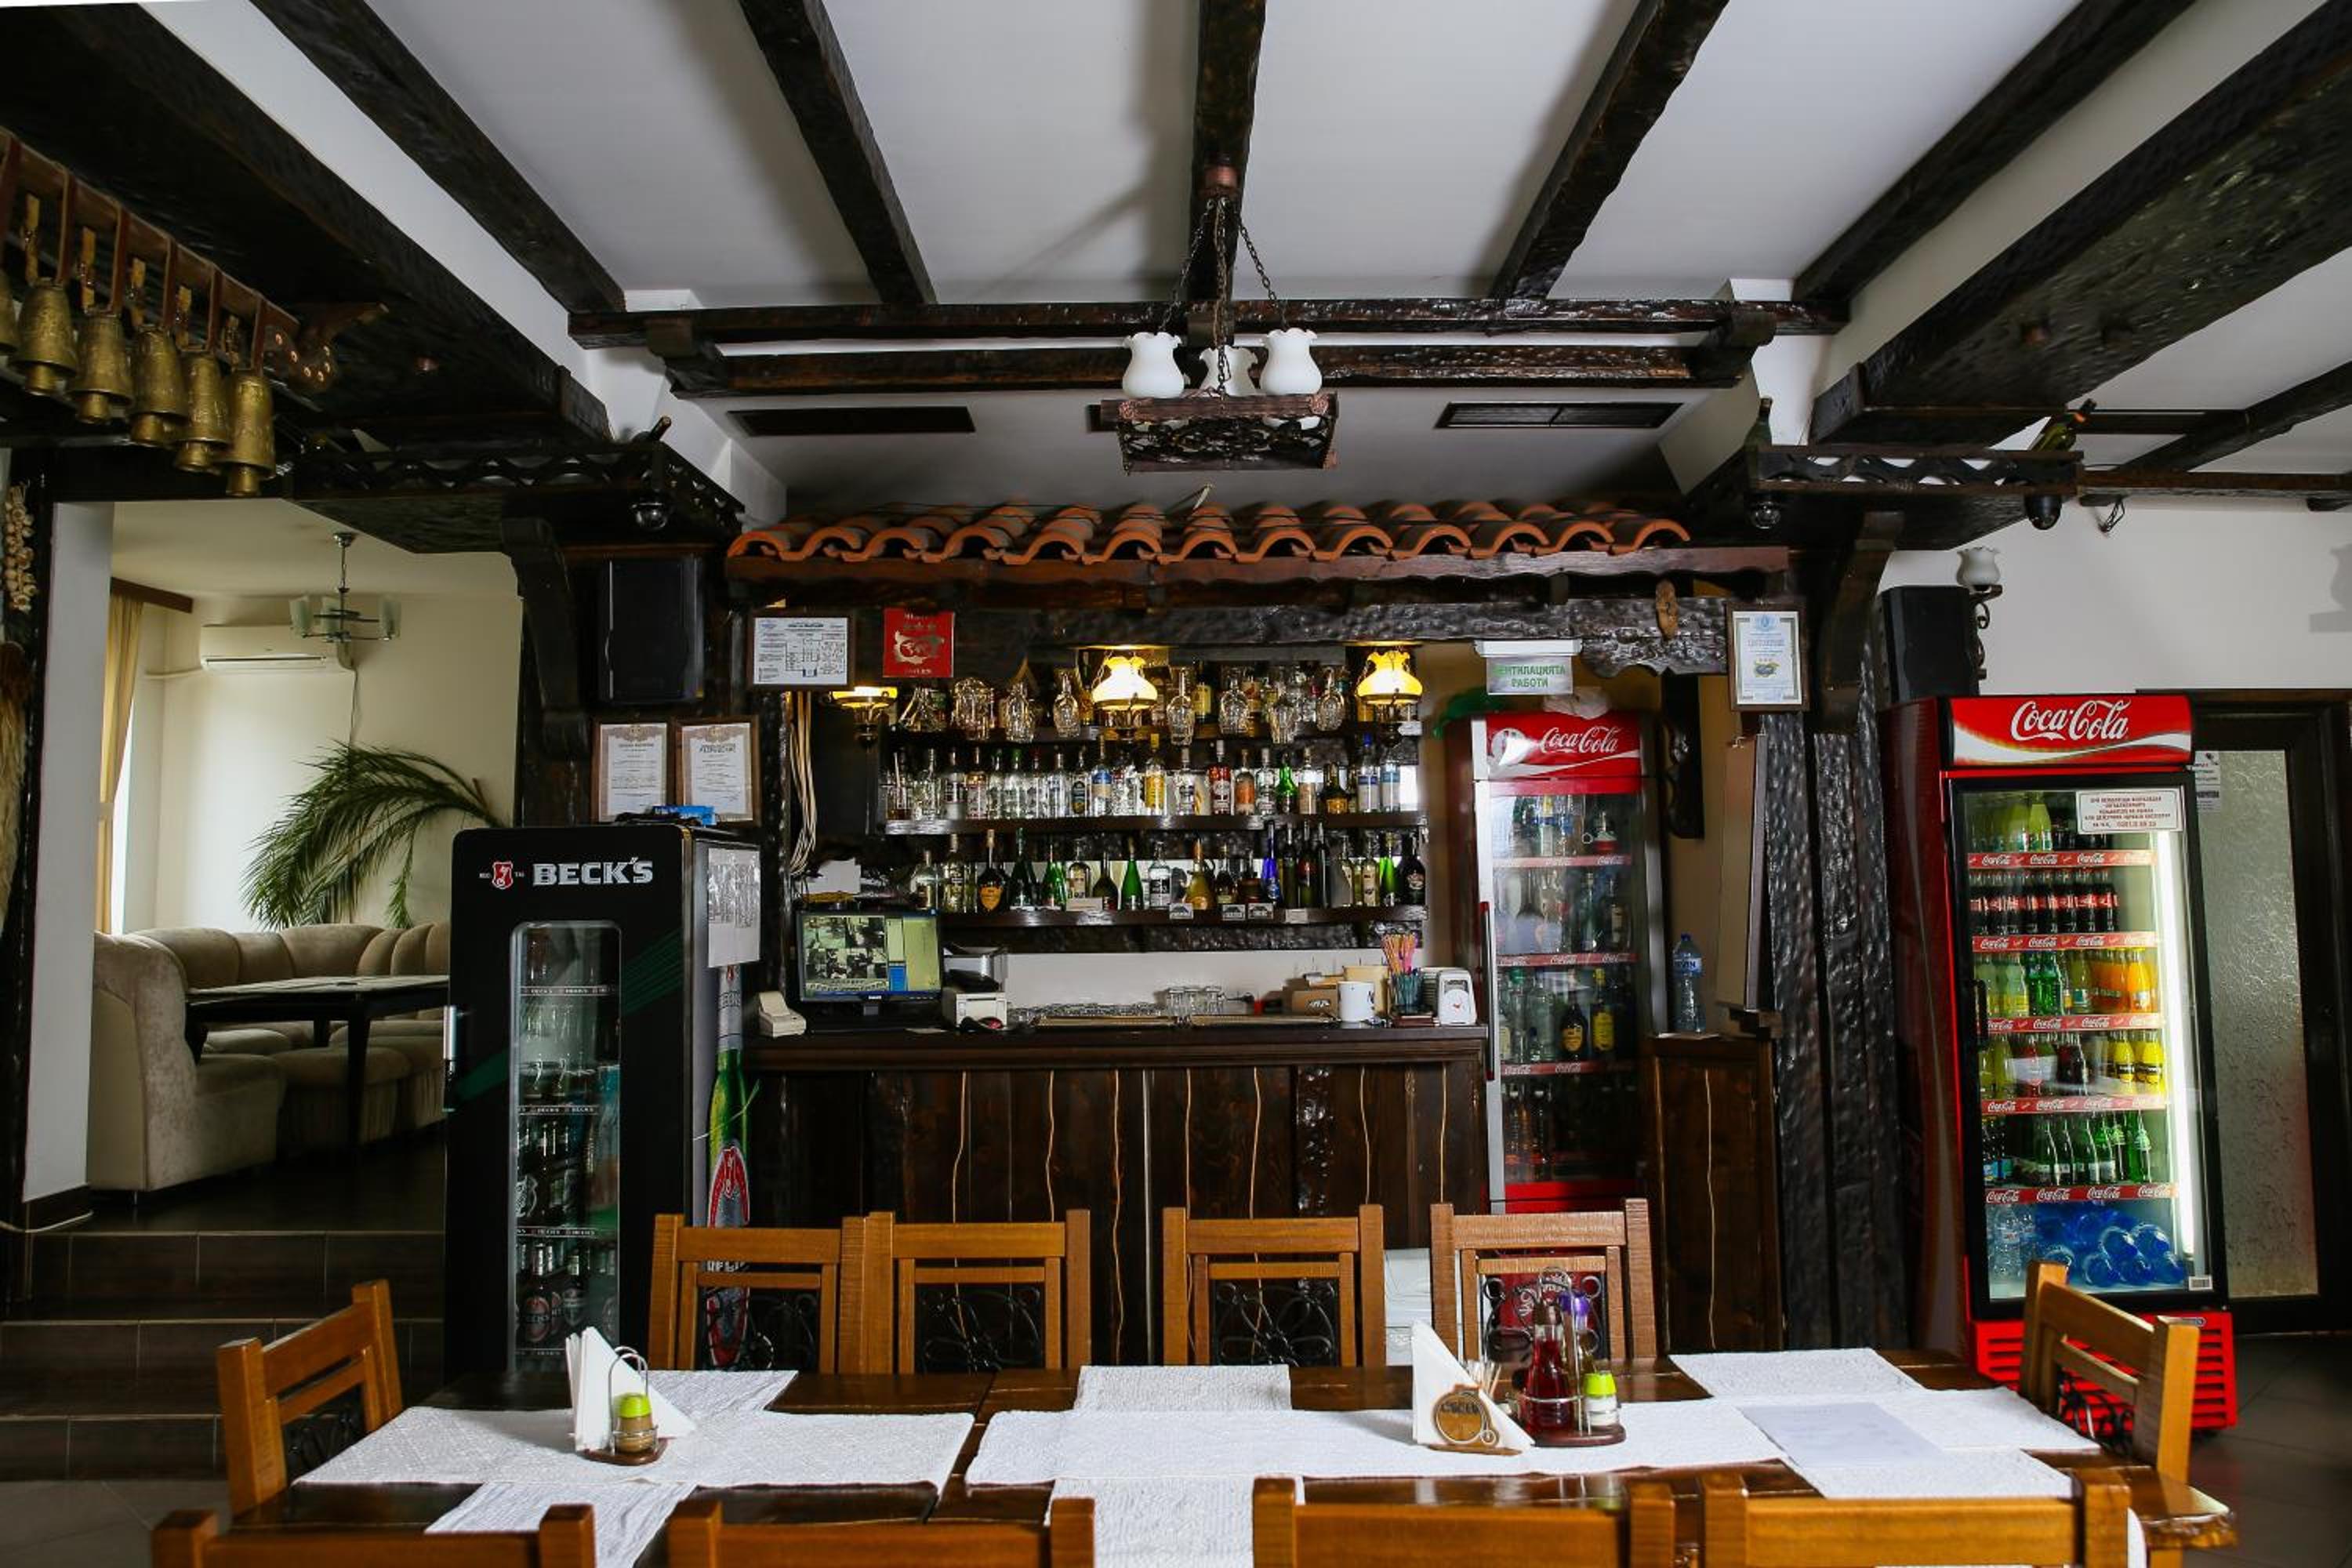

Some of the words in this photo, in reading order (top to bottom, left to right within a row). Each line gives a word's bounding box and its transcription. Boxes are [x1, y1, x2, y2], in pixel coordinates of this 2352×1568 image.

[1511, 677, 1549, 688] РАБОТИ
[2010, 699, 2132, 742] Coca-Cola
[1542, 726, 1621, 753] Coca-Cola
[532, 857, 654, 887] BECK'S
